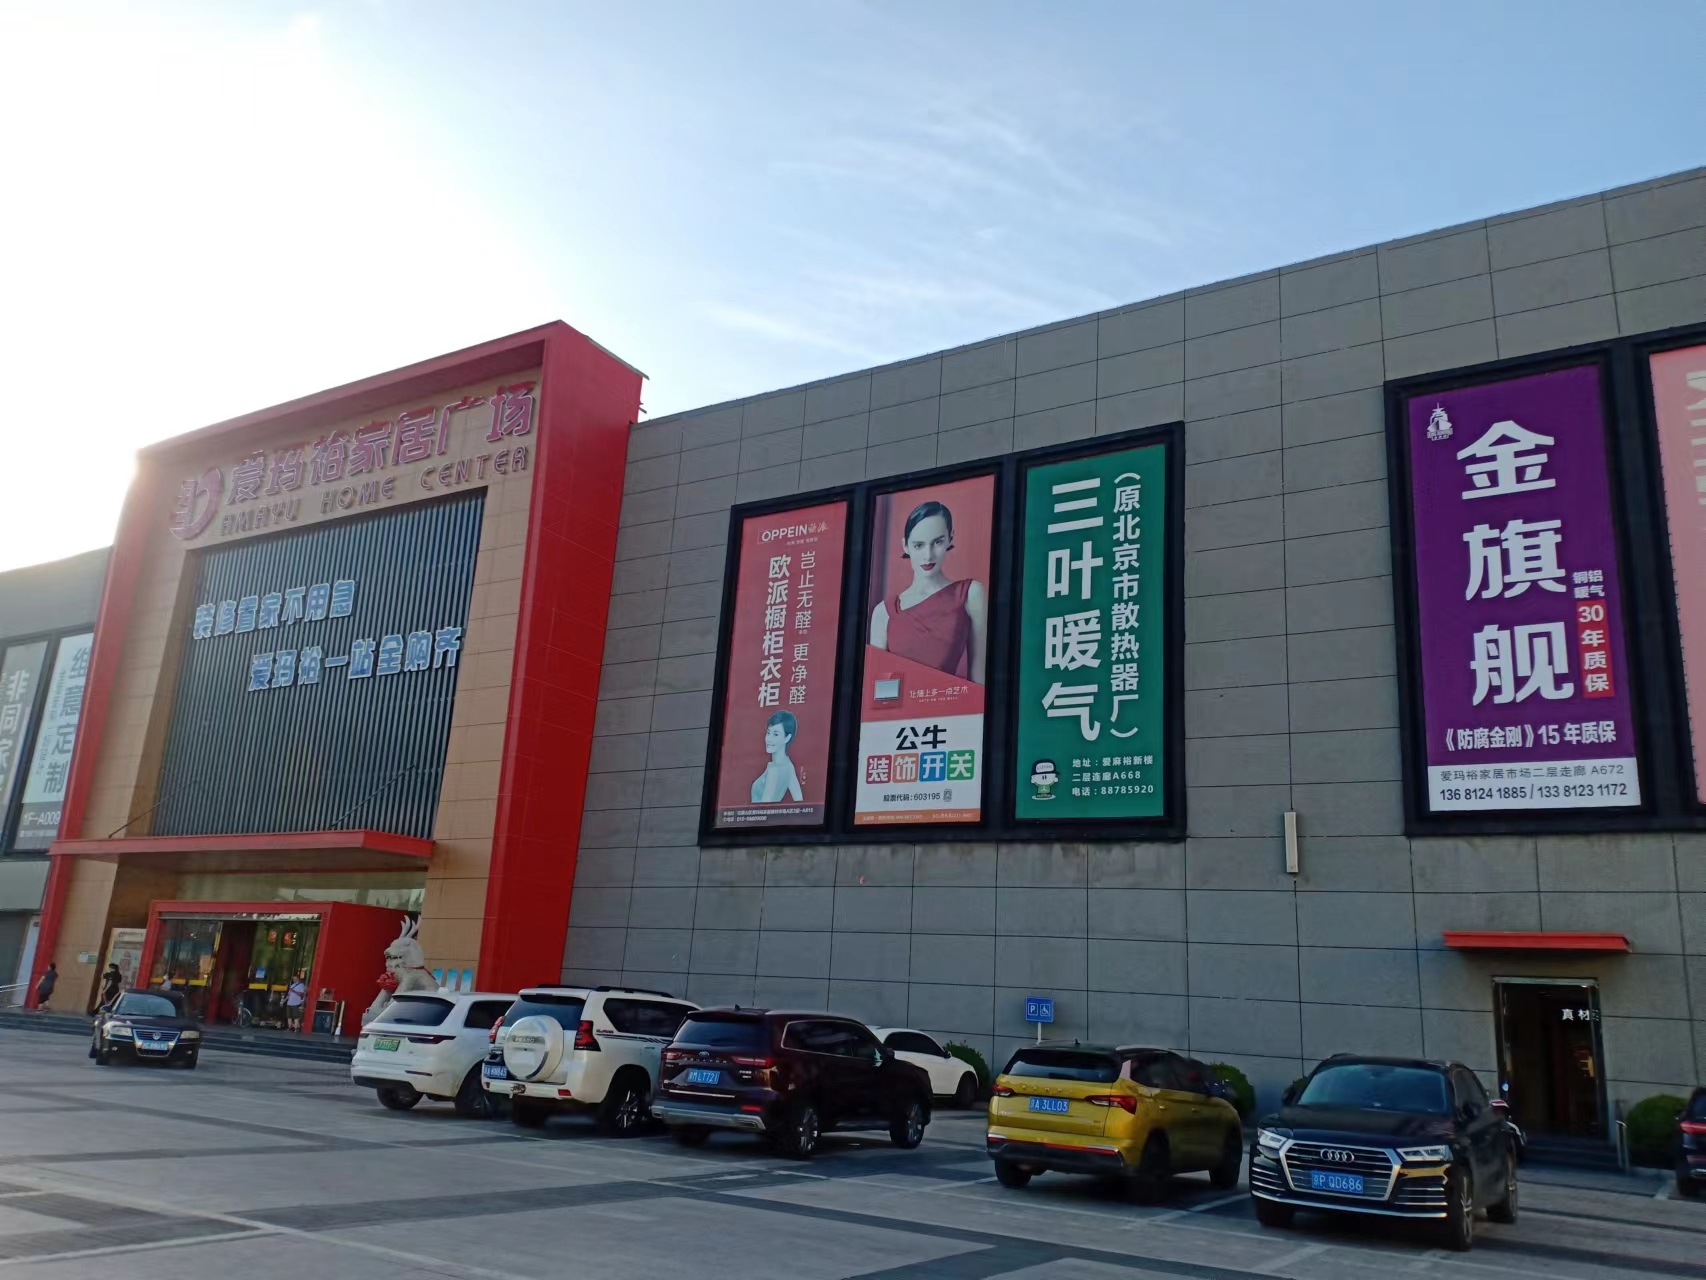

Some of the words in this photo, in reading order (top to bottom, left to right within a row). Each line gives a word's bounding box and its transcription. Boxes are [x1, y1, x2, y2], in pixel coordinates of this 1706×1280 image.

[227, 381, 536, 504] 爱玛裕家居广场
[320, 475, 398, 514] HOME
[419, 445, 527, 491] CENTER
[761, 523, 808, 543] OPPEIN
[1456, 419, 1575, 707] 金旗舰
[193, 579, 356, 640] 装修置家不用急
[795, 550, 816, 630] 岂止无醛
[1041, 477, 1104, 742] 三叶暖气
[1574, 585, 1605, 599] 暖气
[248, 626, 463, 692] 爱玛裕一站全购齐
[757, 555, 792, 708] 欧派橱柜衣柜
[1578, 604, 1610, 693] 30年质保
[866, 751, 976, 784] 装饰开关
[896, 724, 948, 750] 公牛
[1072, 771, 1142, 782] 二层连廊A668
[1439, 788, 1462, 801] 136
[1464, 786, 1494, 800] 8124
[1495, 786, 1528, 799] 1885
[1537, 785, 1560, 798] 133
[1564, 784, 1594, 797] 8123
[1598, 782, 1628, 796] 1172
[1440, 764, 1586, 782] 爱玛裕家居市场二层走廊
[1590, 764, 1625, 776] A672
